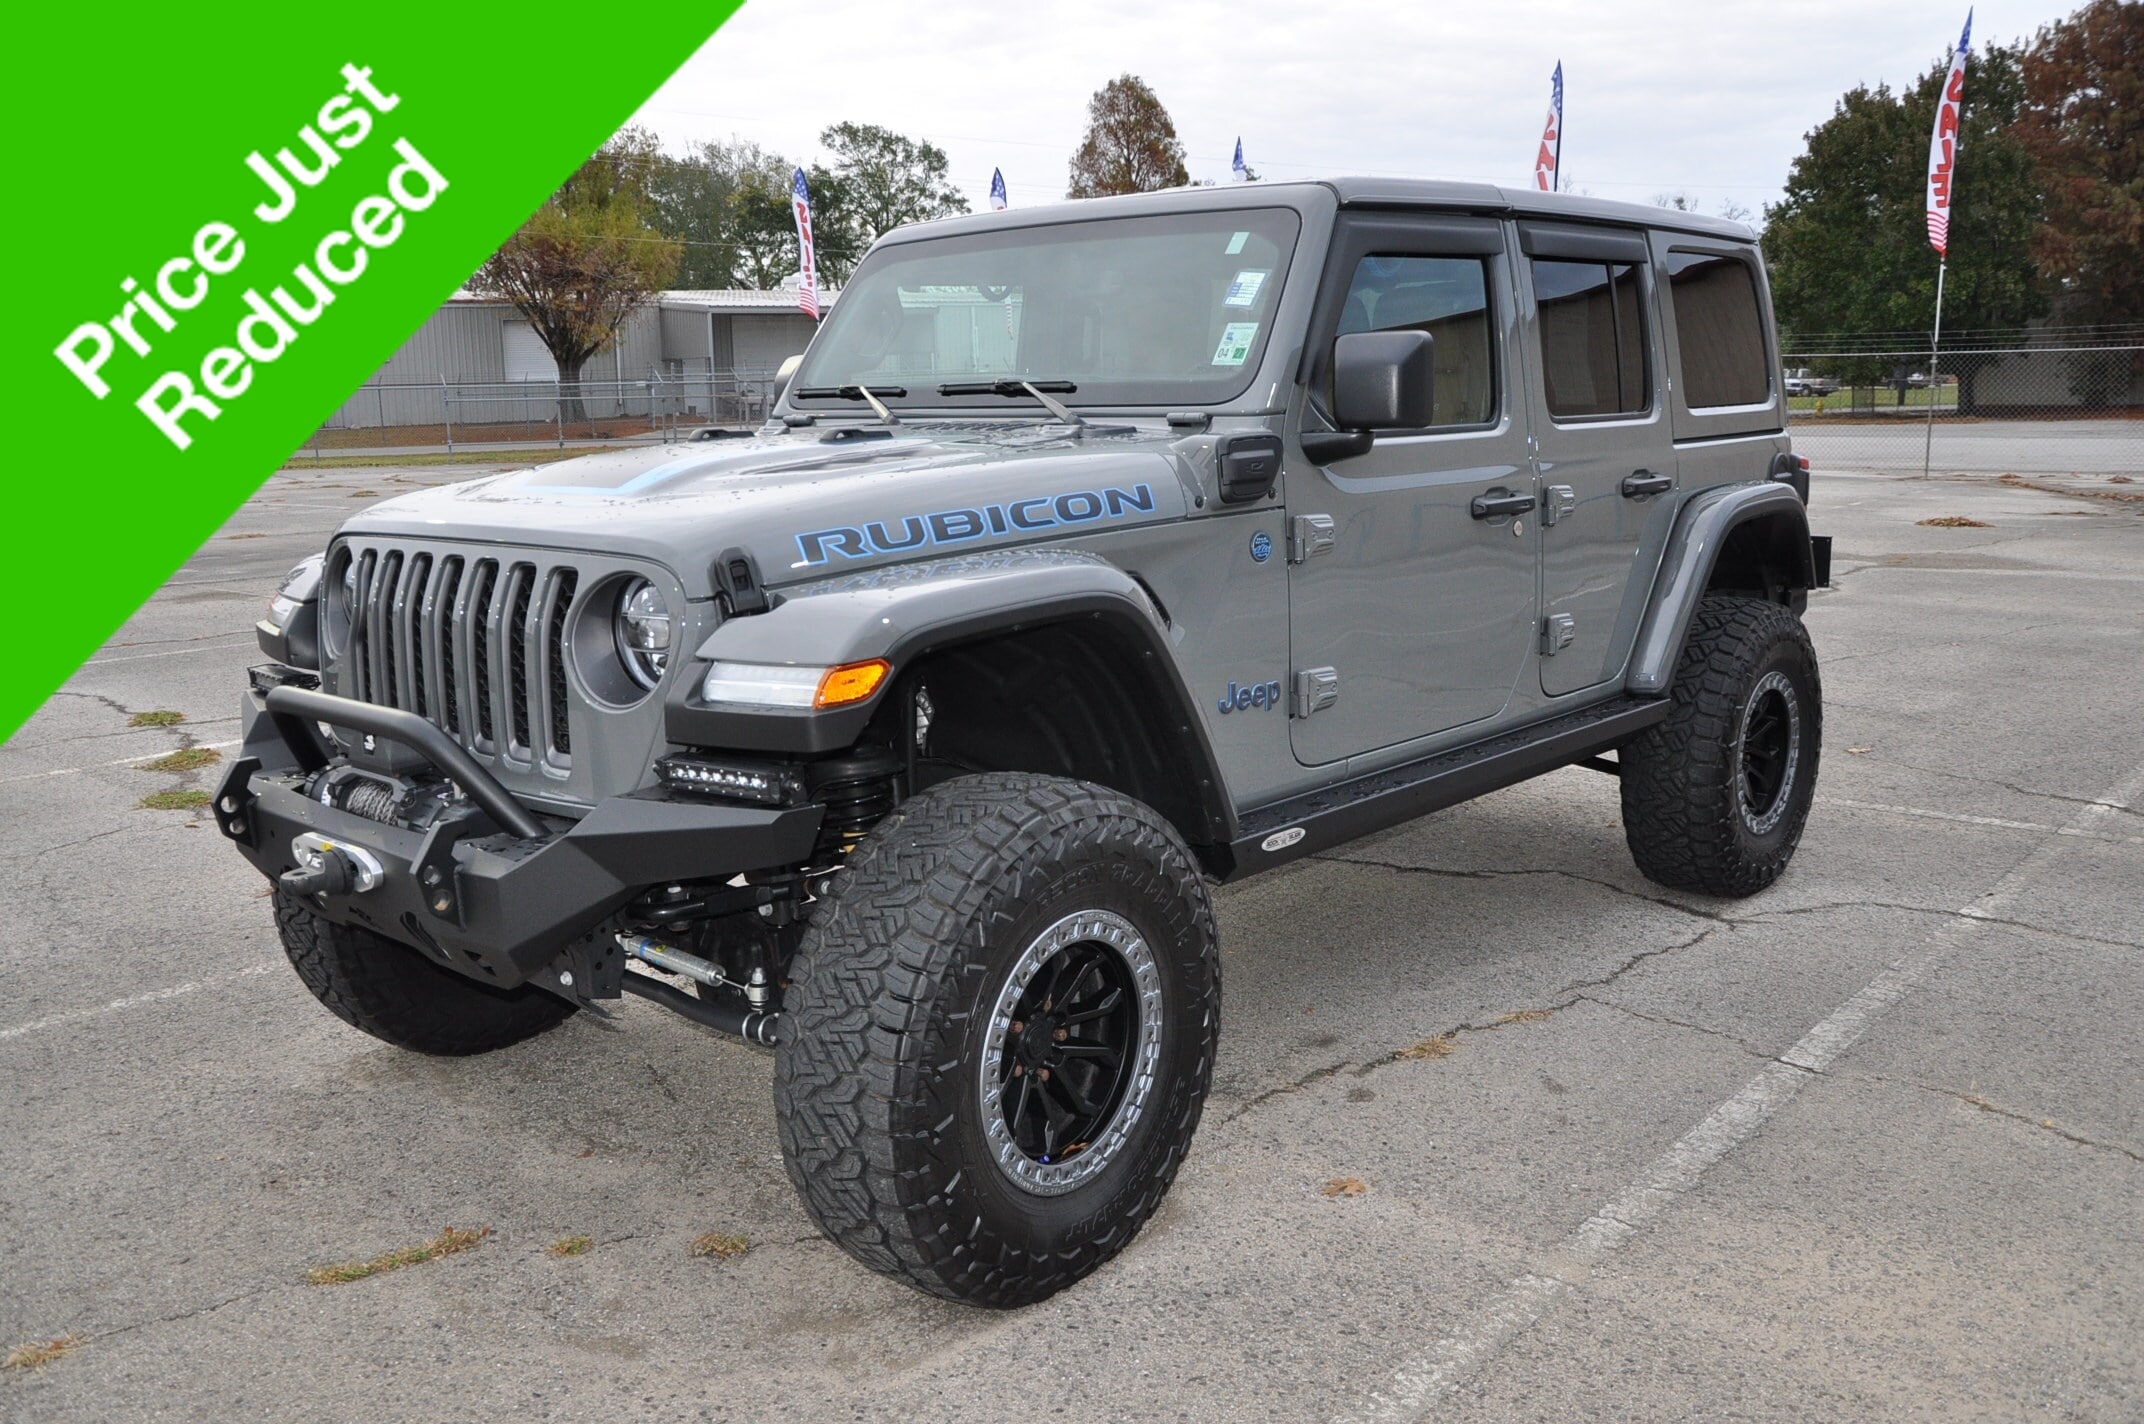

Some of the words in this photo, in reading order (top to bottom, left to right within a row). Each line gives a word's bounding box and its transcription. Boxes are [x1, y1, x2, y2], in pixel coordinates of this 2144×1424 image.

[1217, 347, 1230, 359] 04
[795, 483, 1155, 565] RUBICON
[1218, 680, 1281, 714] Jeep
